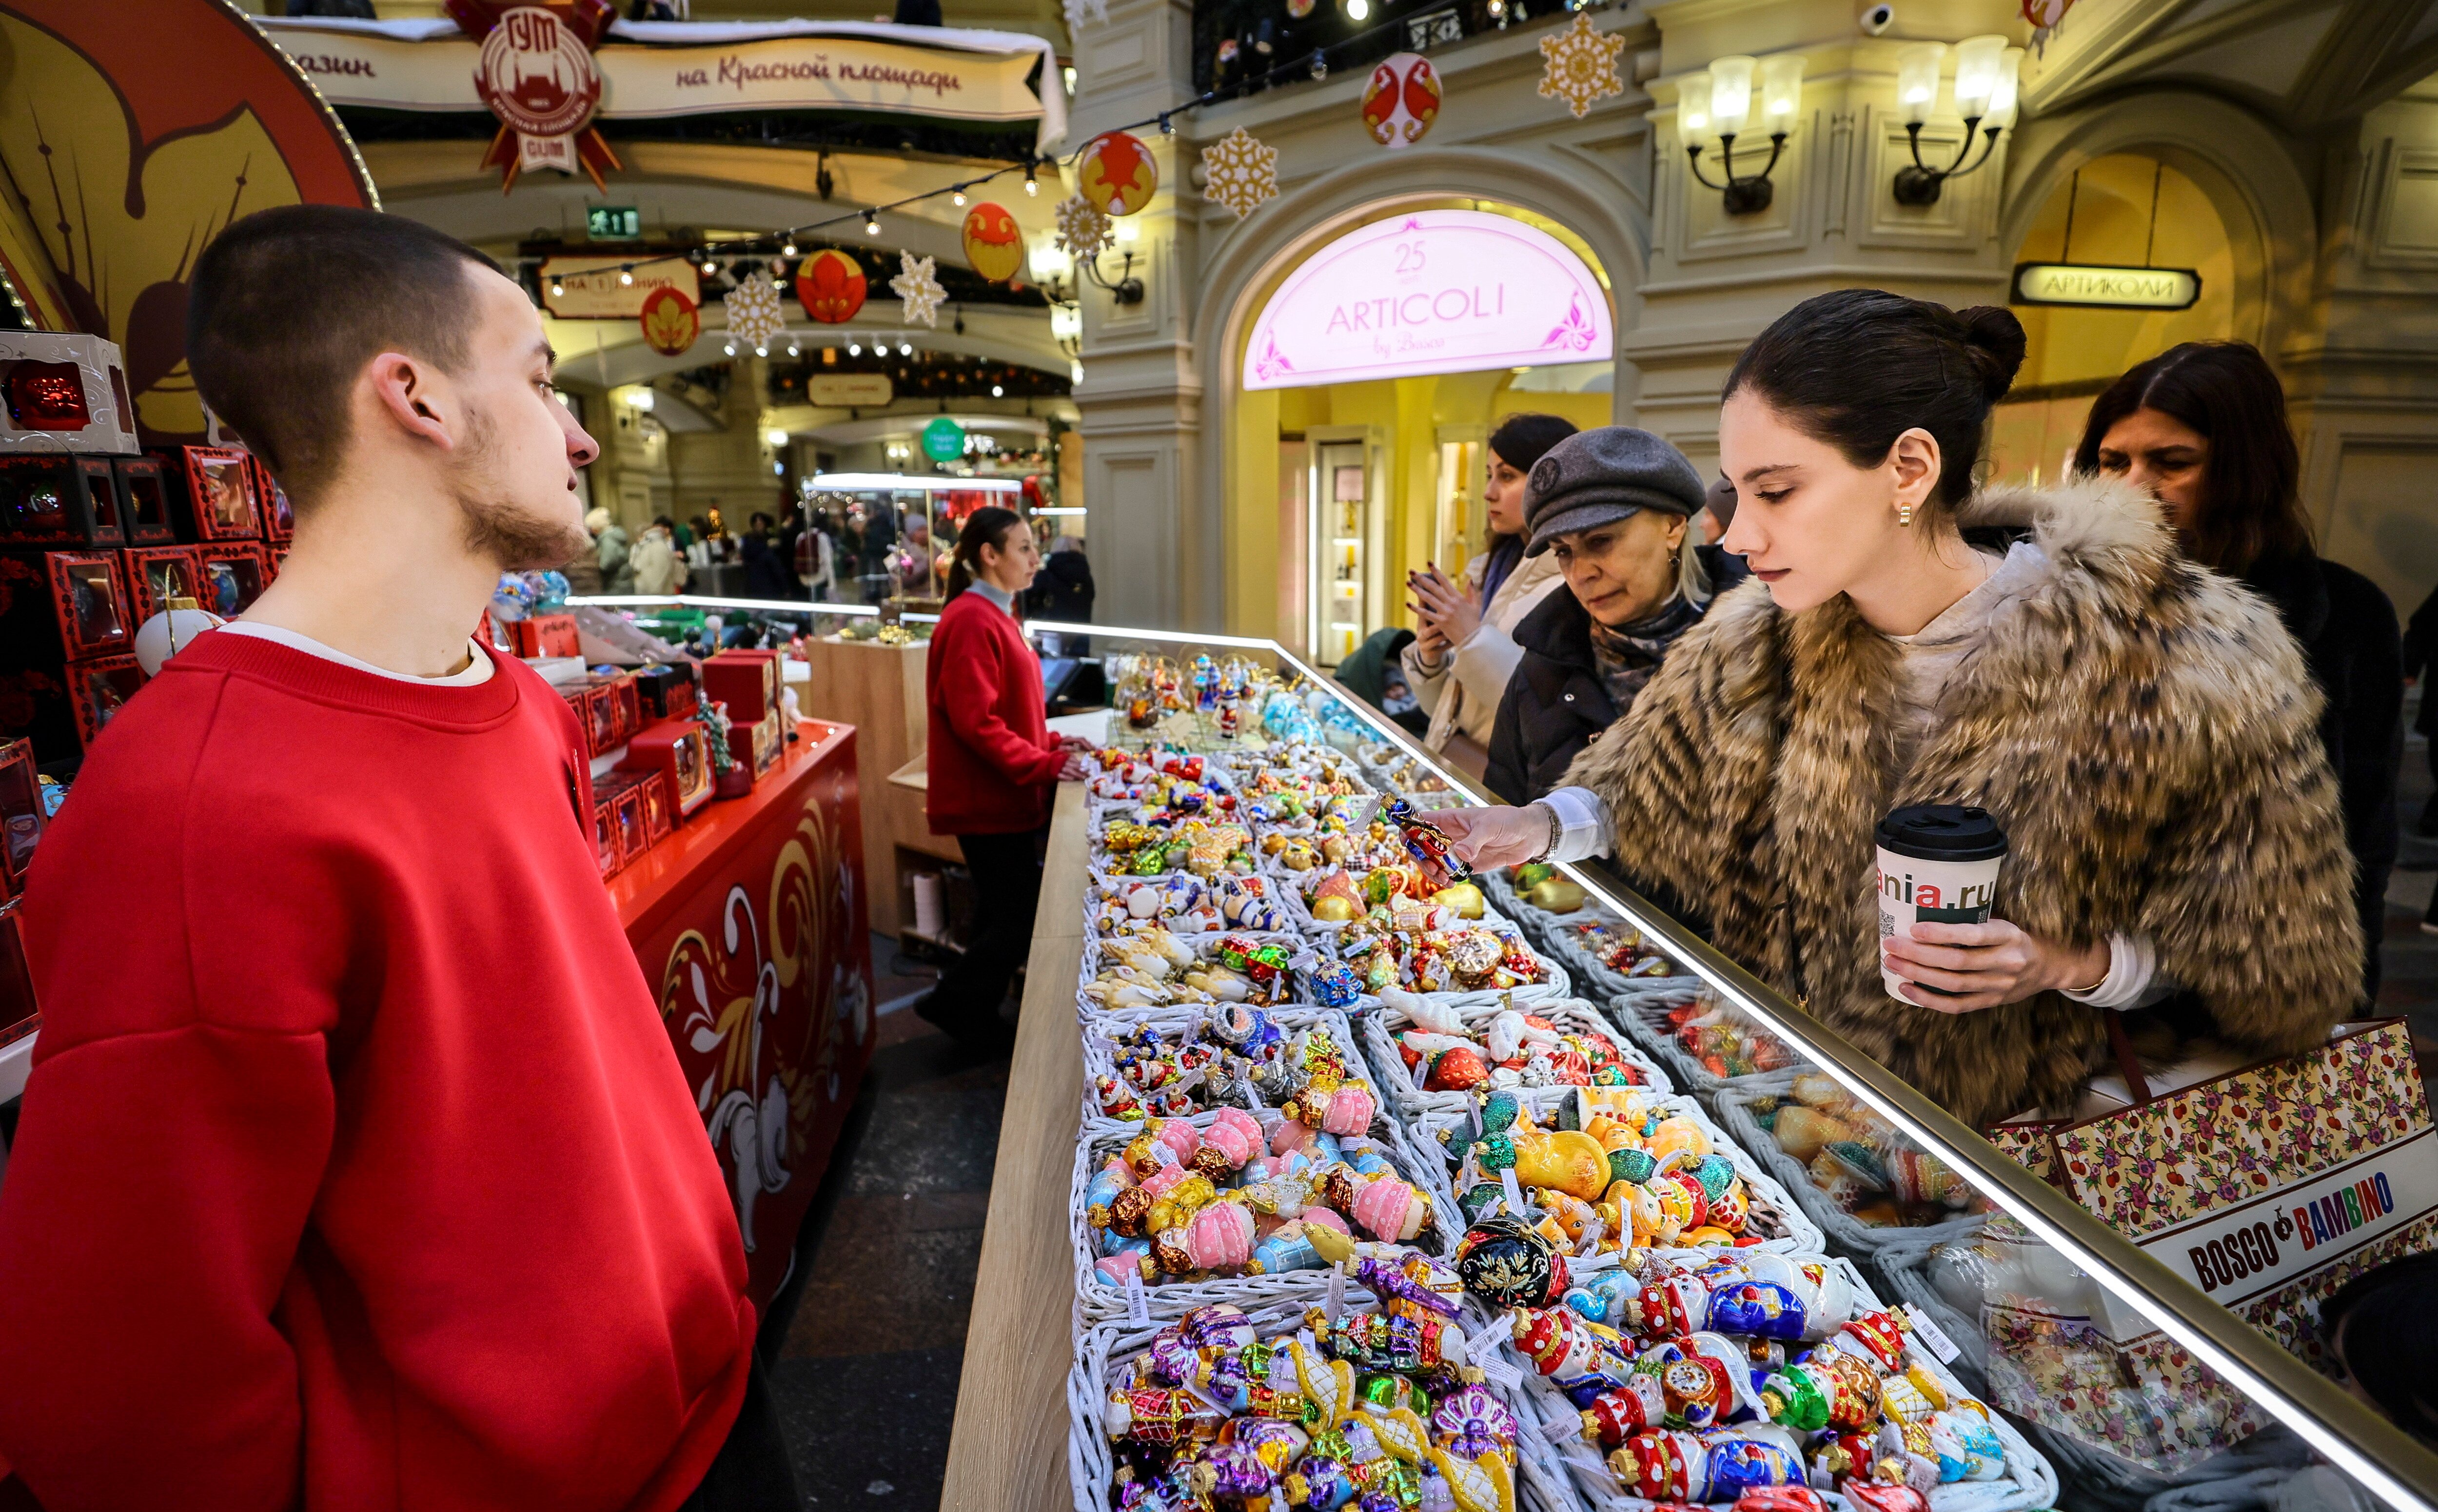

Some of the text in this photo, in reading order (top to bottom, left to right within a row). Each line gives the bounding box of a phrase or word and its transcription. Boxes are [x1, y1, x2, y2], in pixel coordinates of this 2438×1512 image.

[507, 12, 558, 52] ГУМ
[676, 53, 961, 97] на Красной площади
[1395, 240, 1427, 274] 25
[2043, 274, 2175, 299] АРТИКОЛИ
[1326, 282, 1504, 334] ARTICOLI
[2187, 1172, 2394, 1293] BOSCO BAMBINO
